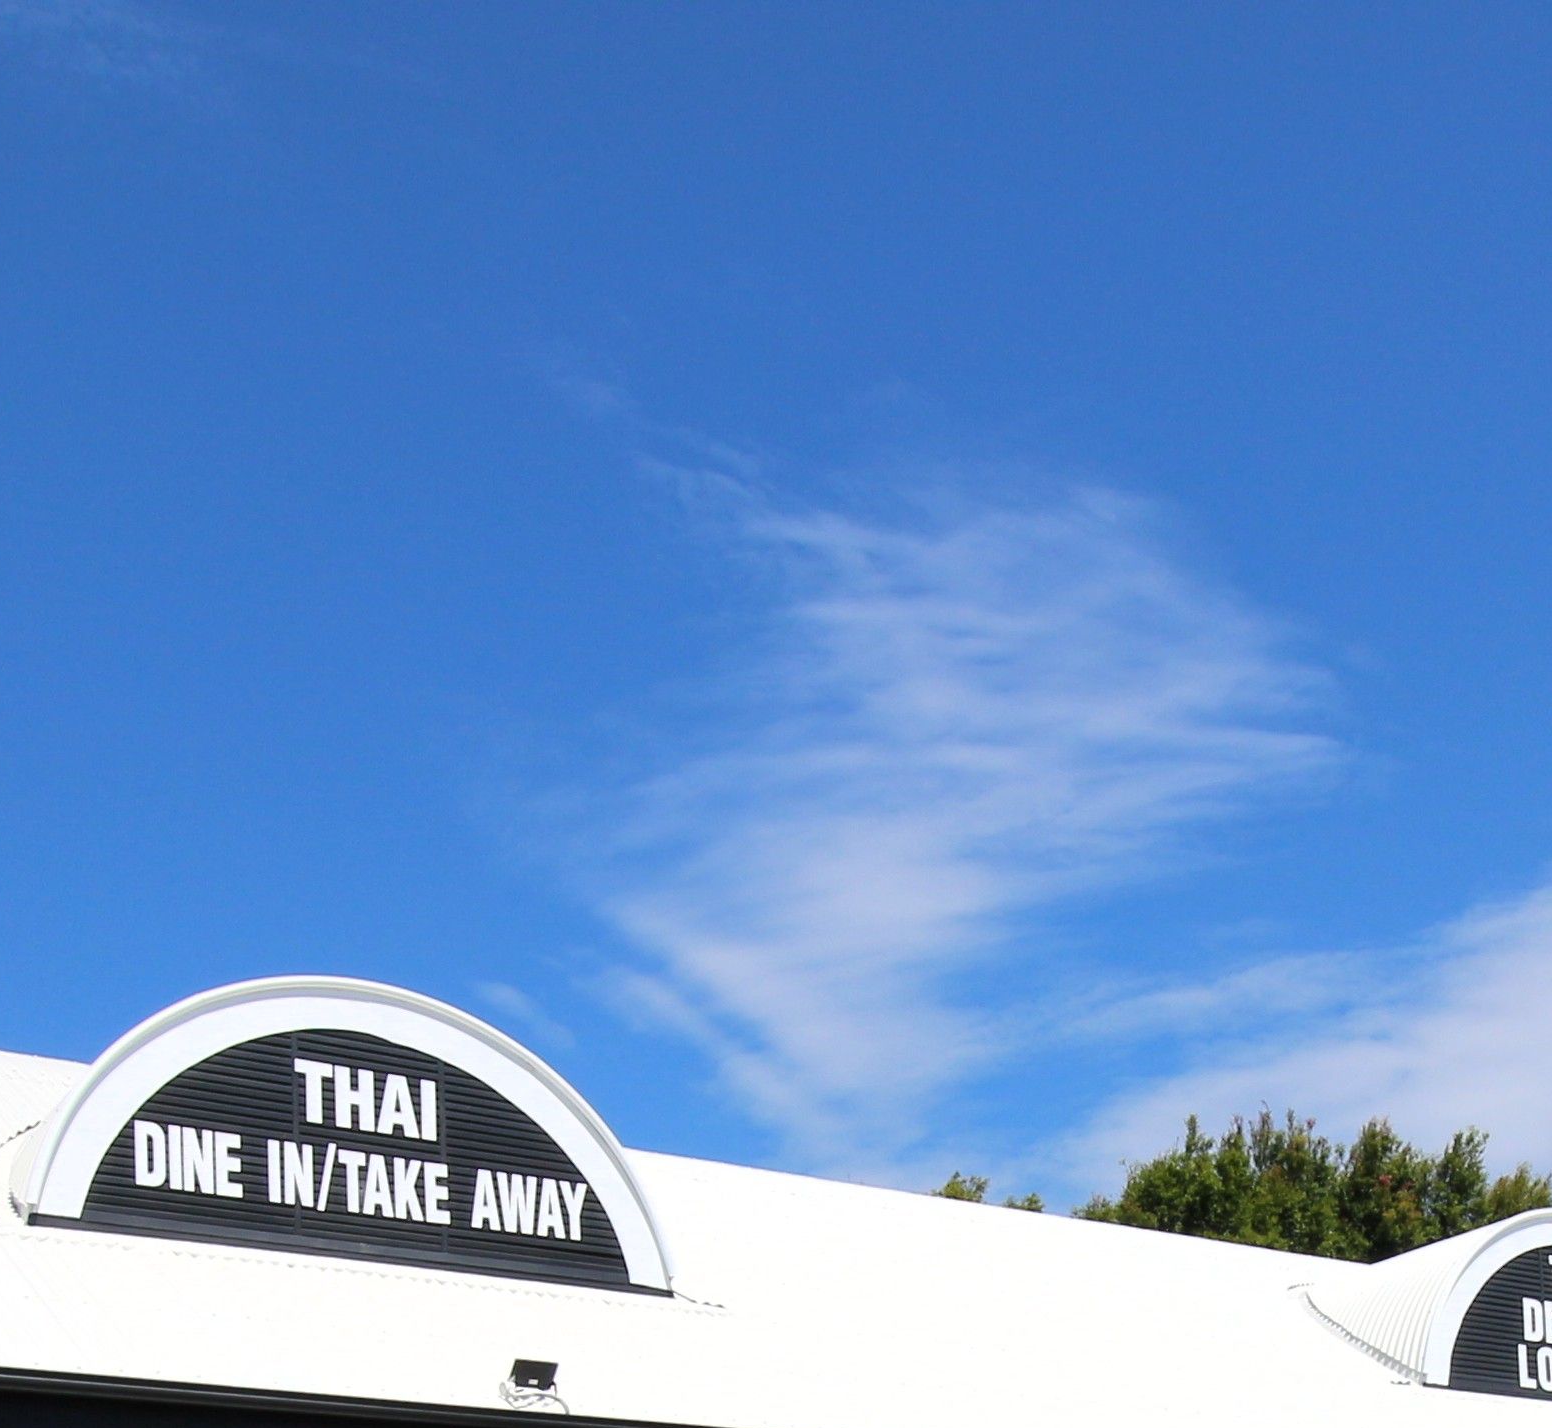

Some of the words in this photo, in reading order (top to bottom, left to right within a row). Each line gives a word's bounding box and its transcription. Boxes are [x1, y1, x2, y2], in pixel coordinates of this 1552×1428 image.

[293, 1057, 438, 1142] THAI
[133, 1119, 244, 1199] DINE
[267, 1139, 452, 1225] IN/TAKE
[471, 1169, 588, 1242] AWAY
